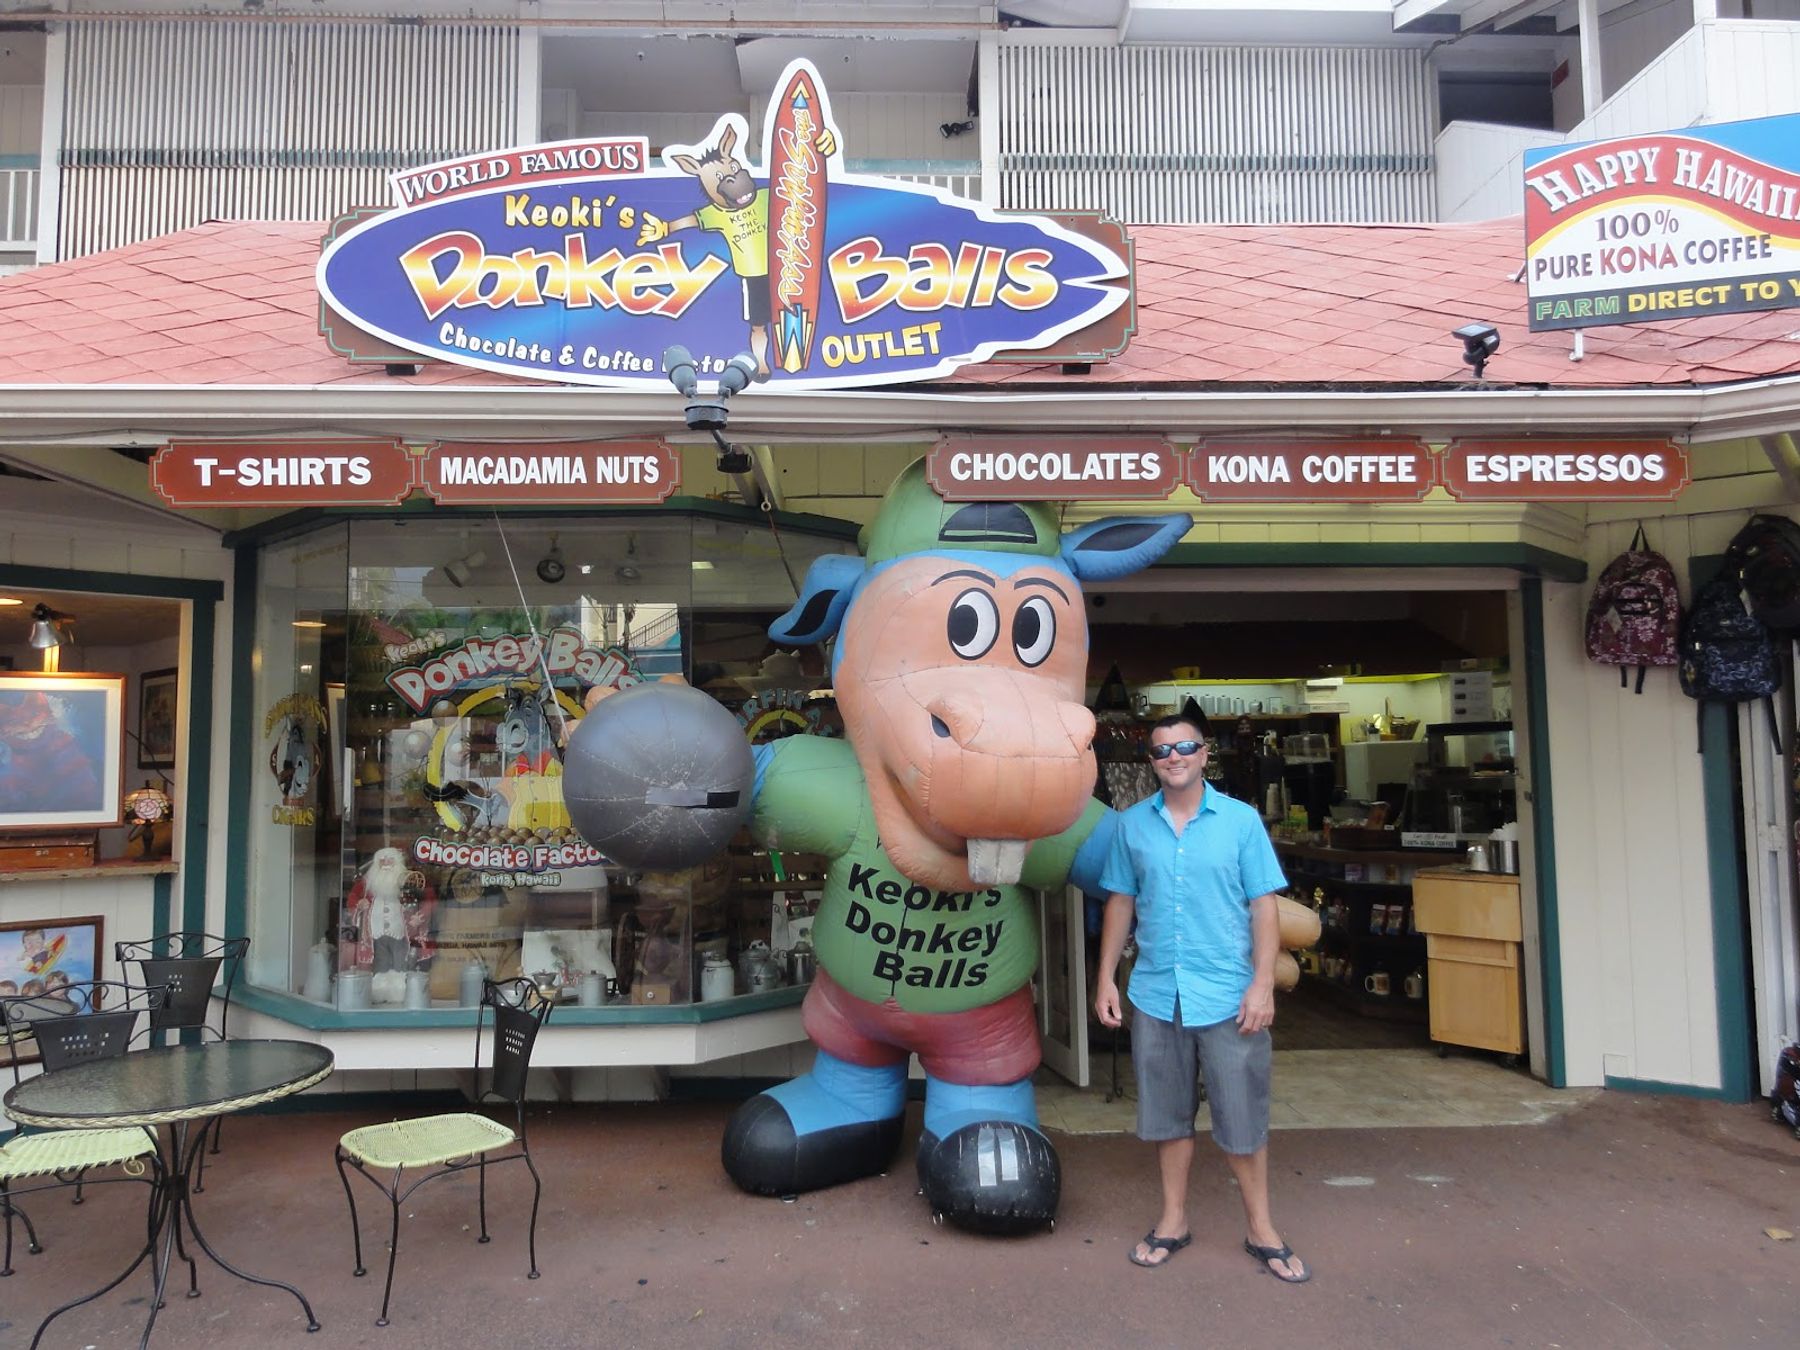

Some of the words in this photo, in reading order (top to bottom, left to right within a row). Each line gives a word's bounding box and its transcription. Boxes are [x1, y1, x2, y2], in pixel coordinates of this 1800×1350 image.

[401, 158, 511, 204] WORLD
[519, 142, 641, 177] FAMOUS
[1525, 147, 1661, 212] HAPPY
[1672, 147, 1800, 221] HAWAII
[505, 193, 635, 228] Keoki's
[739, 219, 758, 231] THE
[1595, 209, 1680, 242] 100%
[732, 223, 767, 243] DONKEY
[1535, 253, 1594, 282] PURE
[1600, 243, 1679, 275] KONA
[1684, 234, 1773, 266] COFFEE
[400, 231, 730, 321] Donkey
[828, 237, 1059, 323] Balls
[1536, 296, 1620, 321] FARM
[1628, 284, 1732, 313] DIRECT
[1740, 281, 1780, 302] TO
[439, 322, 552, 365] Chocolate
[559, 348, 575, 366] &
[582, 347, 655, 373] Coffee
[822, 322, 942, 368] OUTLET
[194, 457, 373, 487] T-SHIRTS
[440, 456, 588, 485] MACADAMIA
[596, 456, 660, 485] NUTS
[949, 452, 1162, 482] CHOCOLATES
[1207, 454, 1291, 483] KONA
[1302, 454, 1417, 484] COFFEE
[1466, 453, 1665, 483] ESPRESSOS
[390, 637, 549, 708] Donkey
[415, 841, 531, 869] Chocolate
[845, 901, 1004, 957] Donkey
[873, 951, 989, 989] Balls
